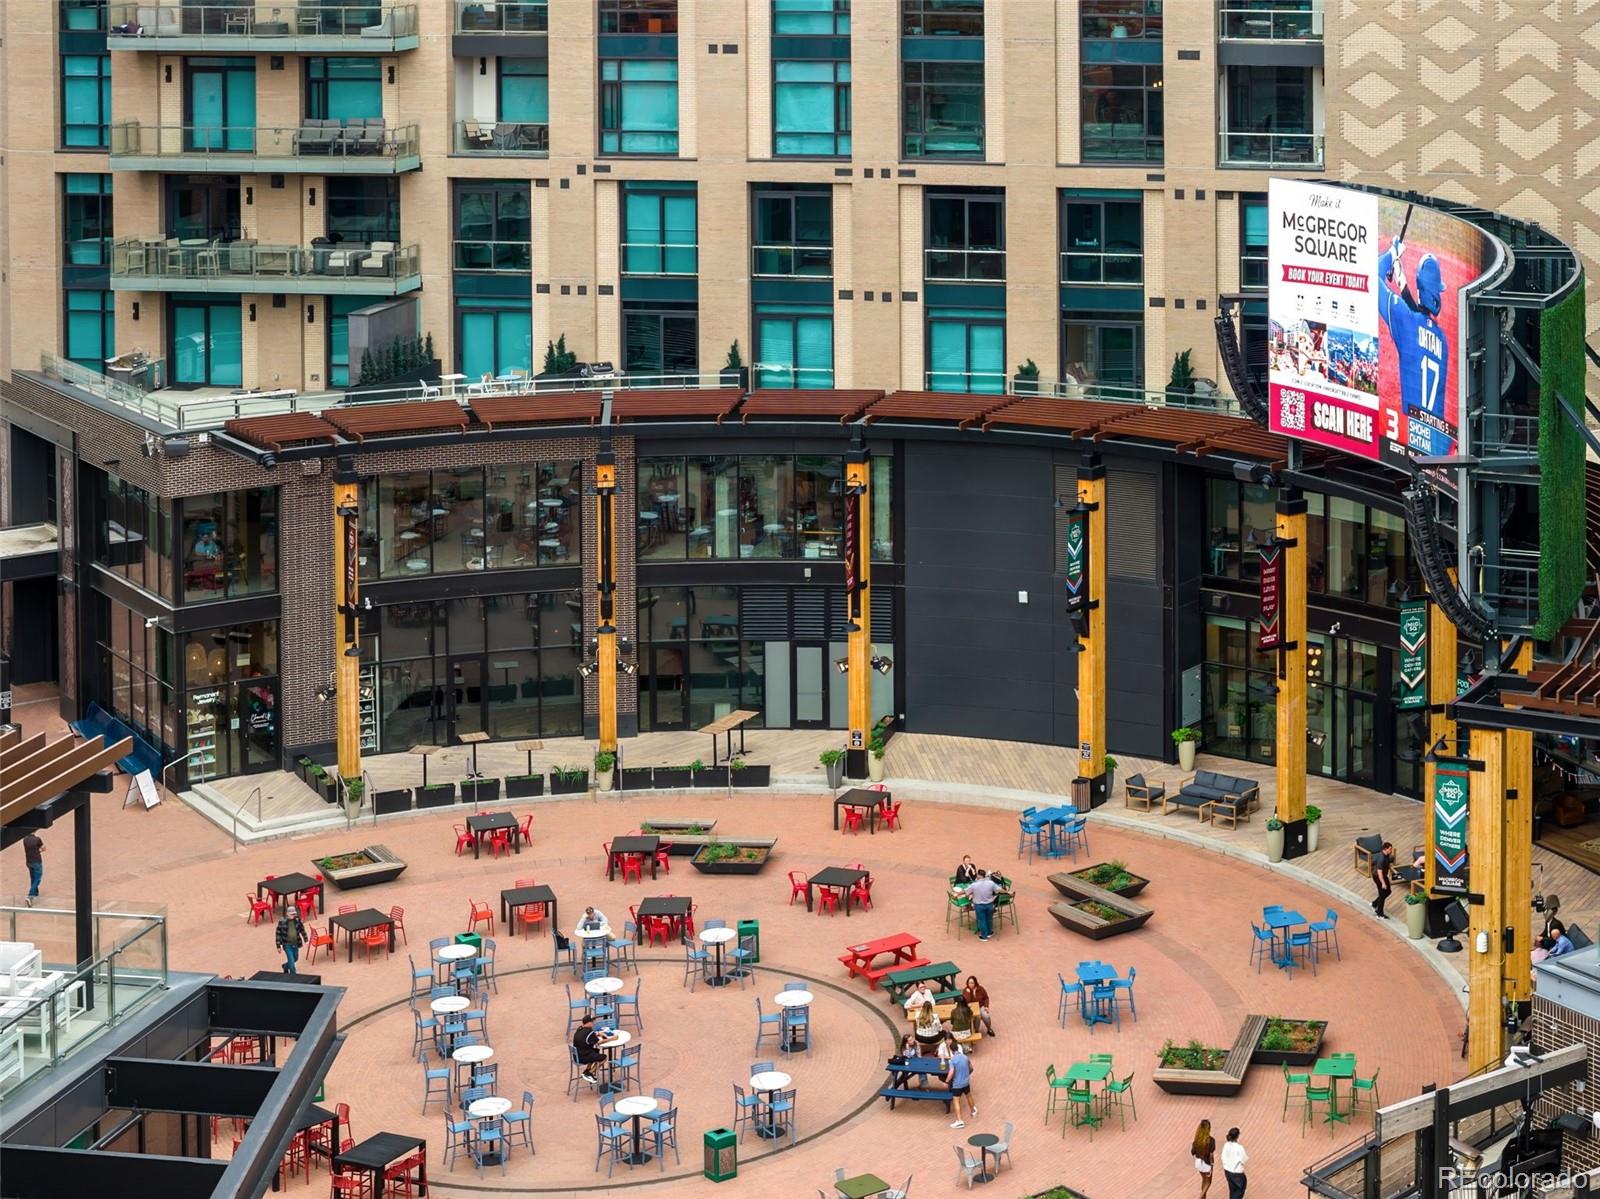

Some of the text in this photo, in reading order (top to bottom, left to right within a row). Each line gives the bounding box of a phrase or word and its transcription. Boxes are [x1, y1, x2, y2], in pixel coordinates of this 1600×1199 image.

[1309, 194, 1342, 210] Make it
[1294, 235, 1358, 264] SQUARE
[1288, 268, 1365, 290] BOOK YOUR EVENT TODAY!
[1418, 325, 1443, 360] OHTANI
[1420, 355, 1440, 411] 17
[1313, 401, 1373, 443] SCAN HERE
[1386, 408, 1399, 441] 3
[1409, 420, 1431, 439] SHOHEI
[1420, 410, 1445, 431] STARTING
[1389, 441, 1406, 456] ESPN
[1439, 829, 1460, 838] WHERE
[1439, 835, 1461, 844] DENVER
[1439, 841, 1460, 850] GATHERS
